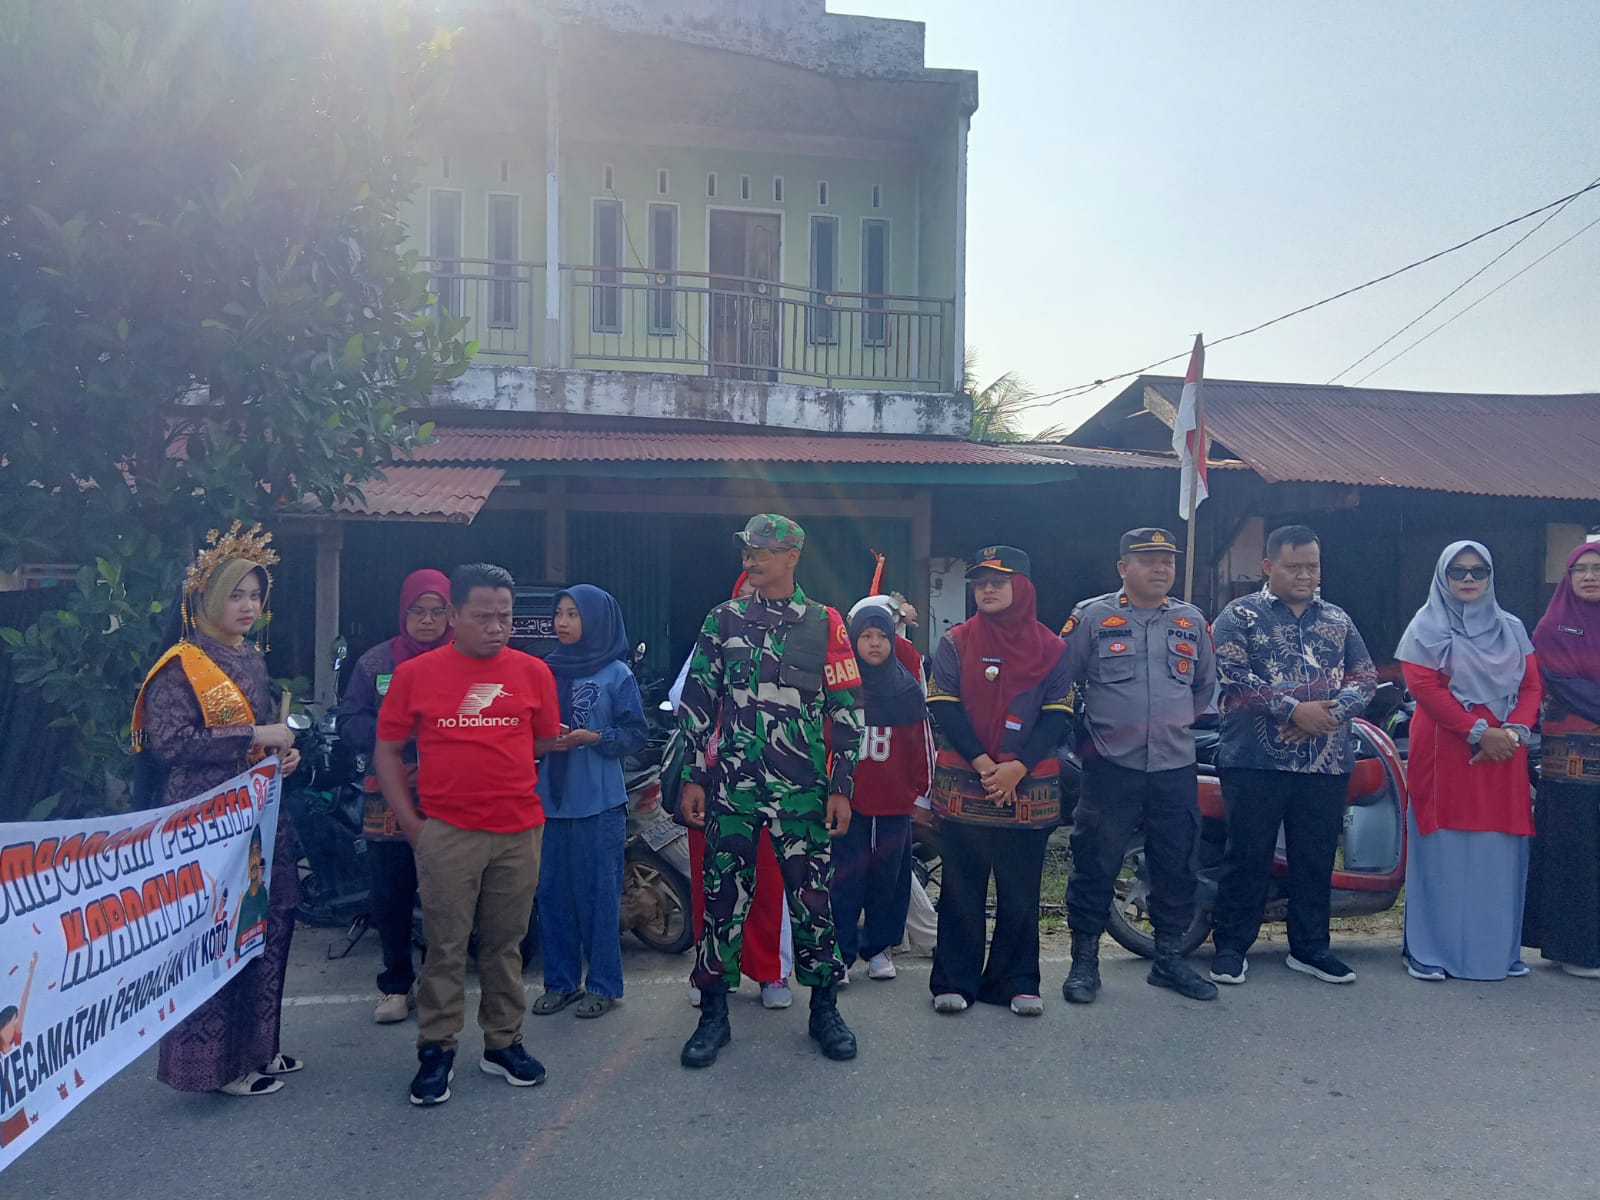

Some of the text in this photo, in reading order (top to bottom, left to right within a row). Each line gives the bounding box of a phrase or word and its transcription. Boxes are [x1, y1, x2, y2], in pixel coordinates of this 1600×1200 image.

[1168, 629, 1197, 641] POLRI
[437, 714, 520, 728] no balance
[0, 785, 255, 925] MBONGAN PESERTA
[60, 860, 210, 992] KARNAVAL
[0, 995, 113, 1115] KECAMATAN
[111, 947, 187, 1031] PENDALIAN
[201, 919, 229, 968] KOTO
